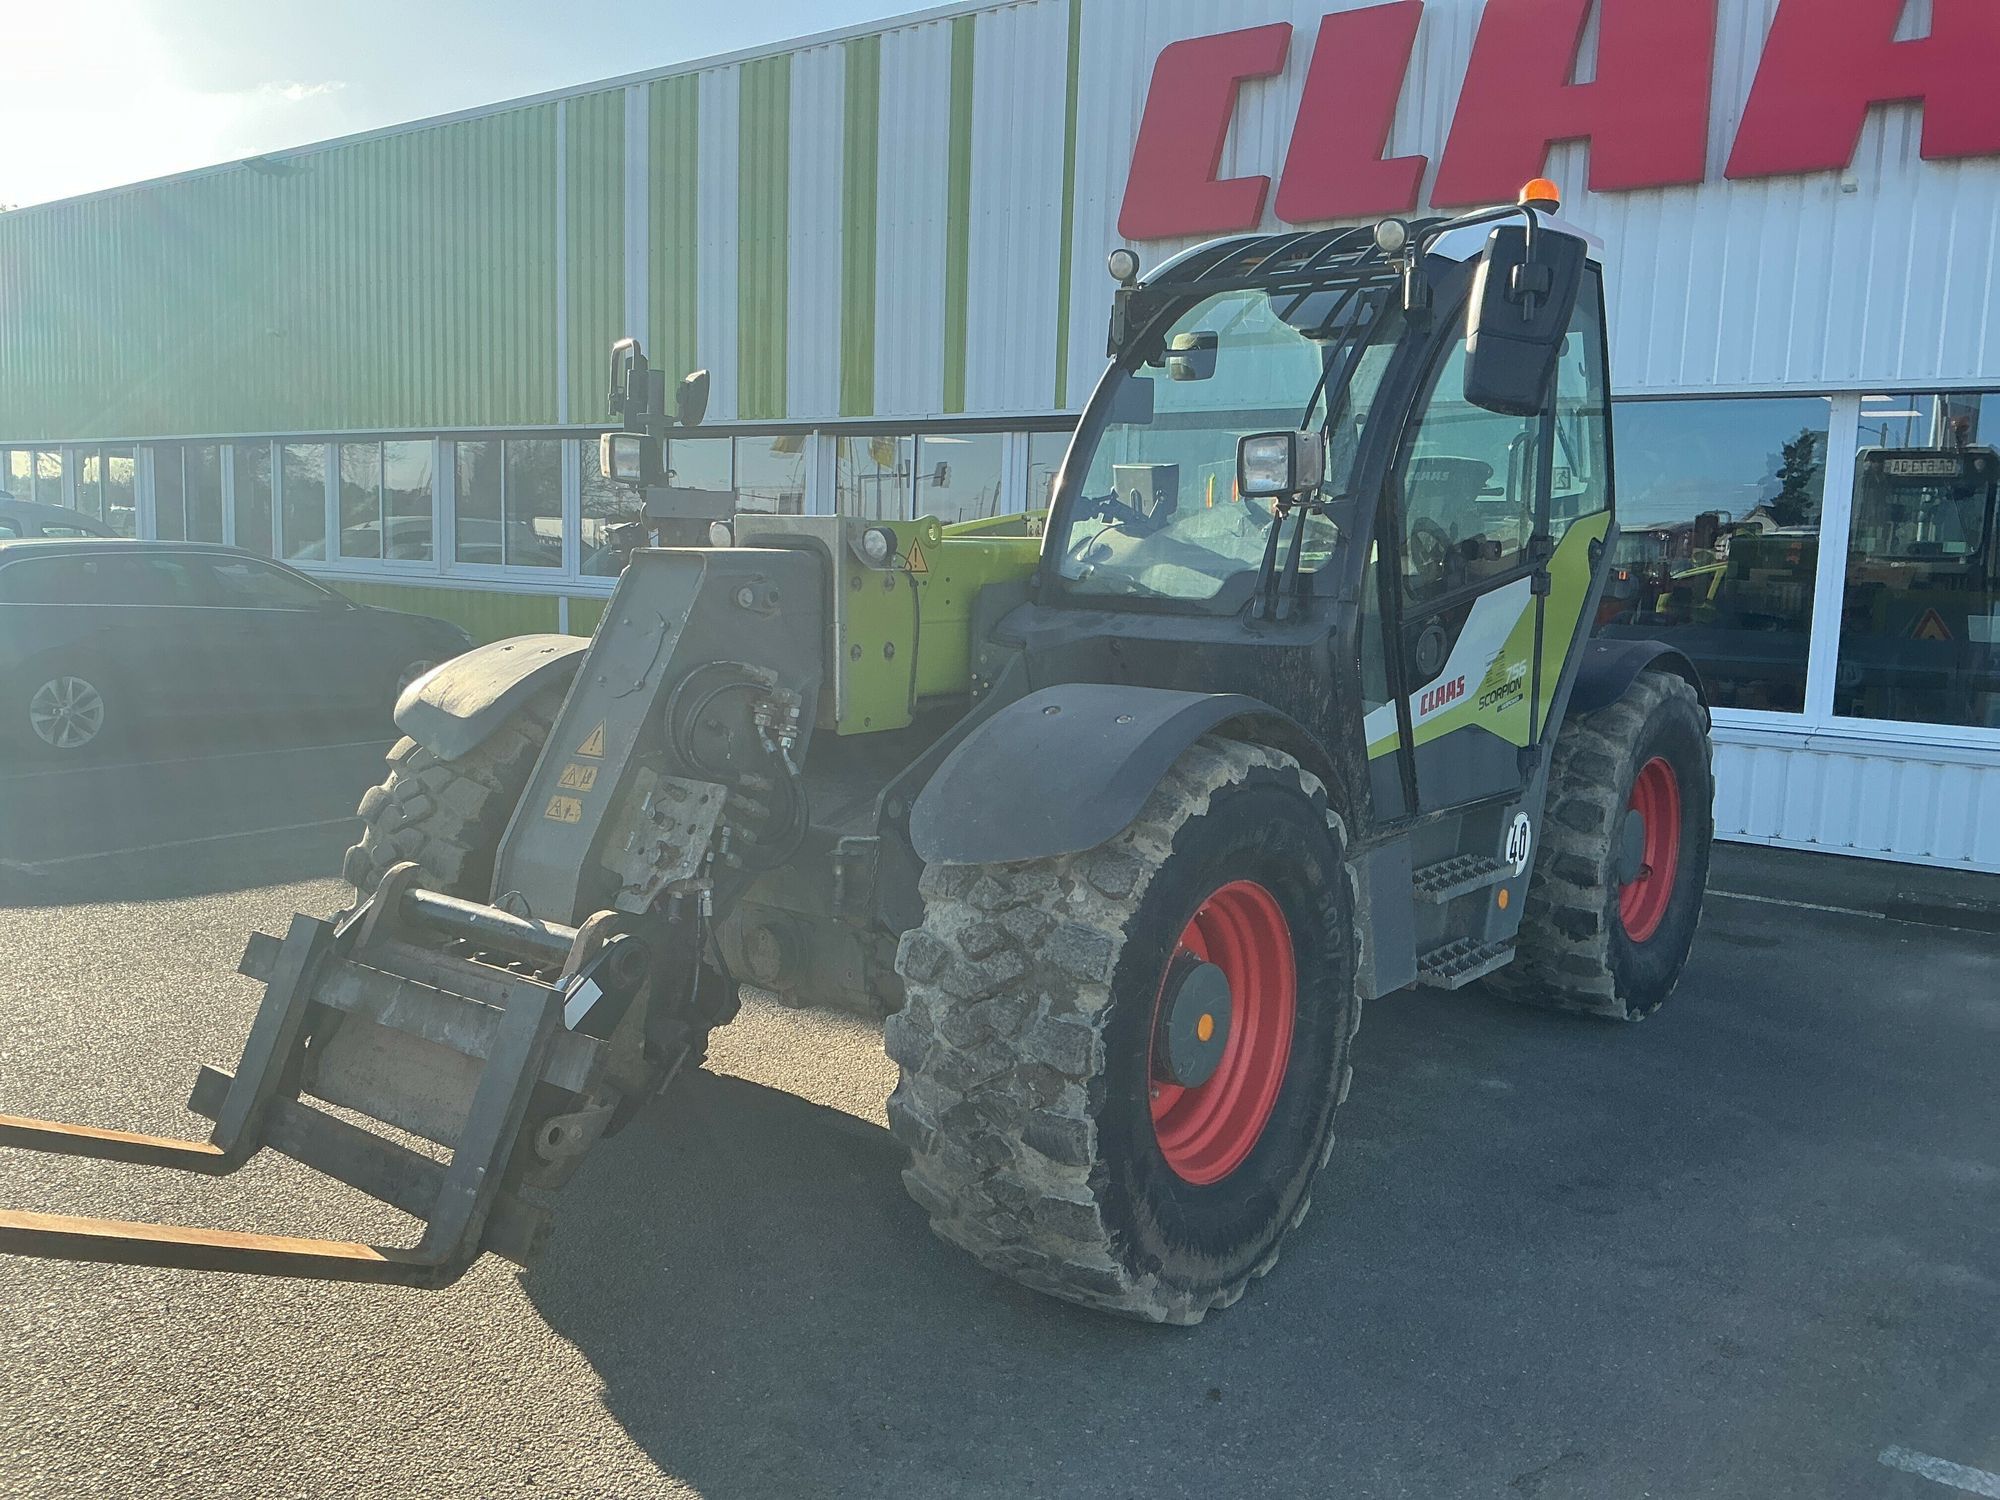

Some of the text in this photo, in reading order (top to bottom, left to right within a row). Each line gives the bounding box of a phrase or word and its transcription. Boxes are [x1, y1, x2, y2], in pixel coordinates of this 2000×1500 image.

[1506, 659, 1527, 684] 756
[1420, 675, 1465, 716] CLAAS
[1478, 677, 1522, 711] SCORPION
[1510, 822, 1527, 862] 40
